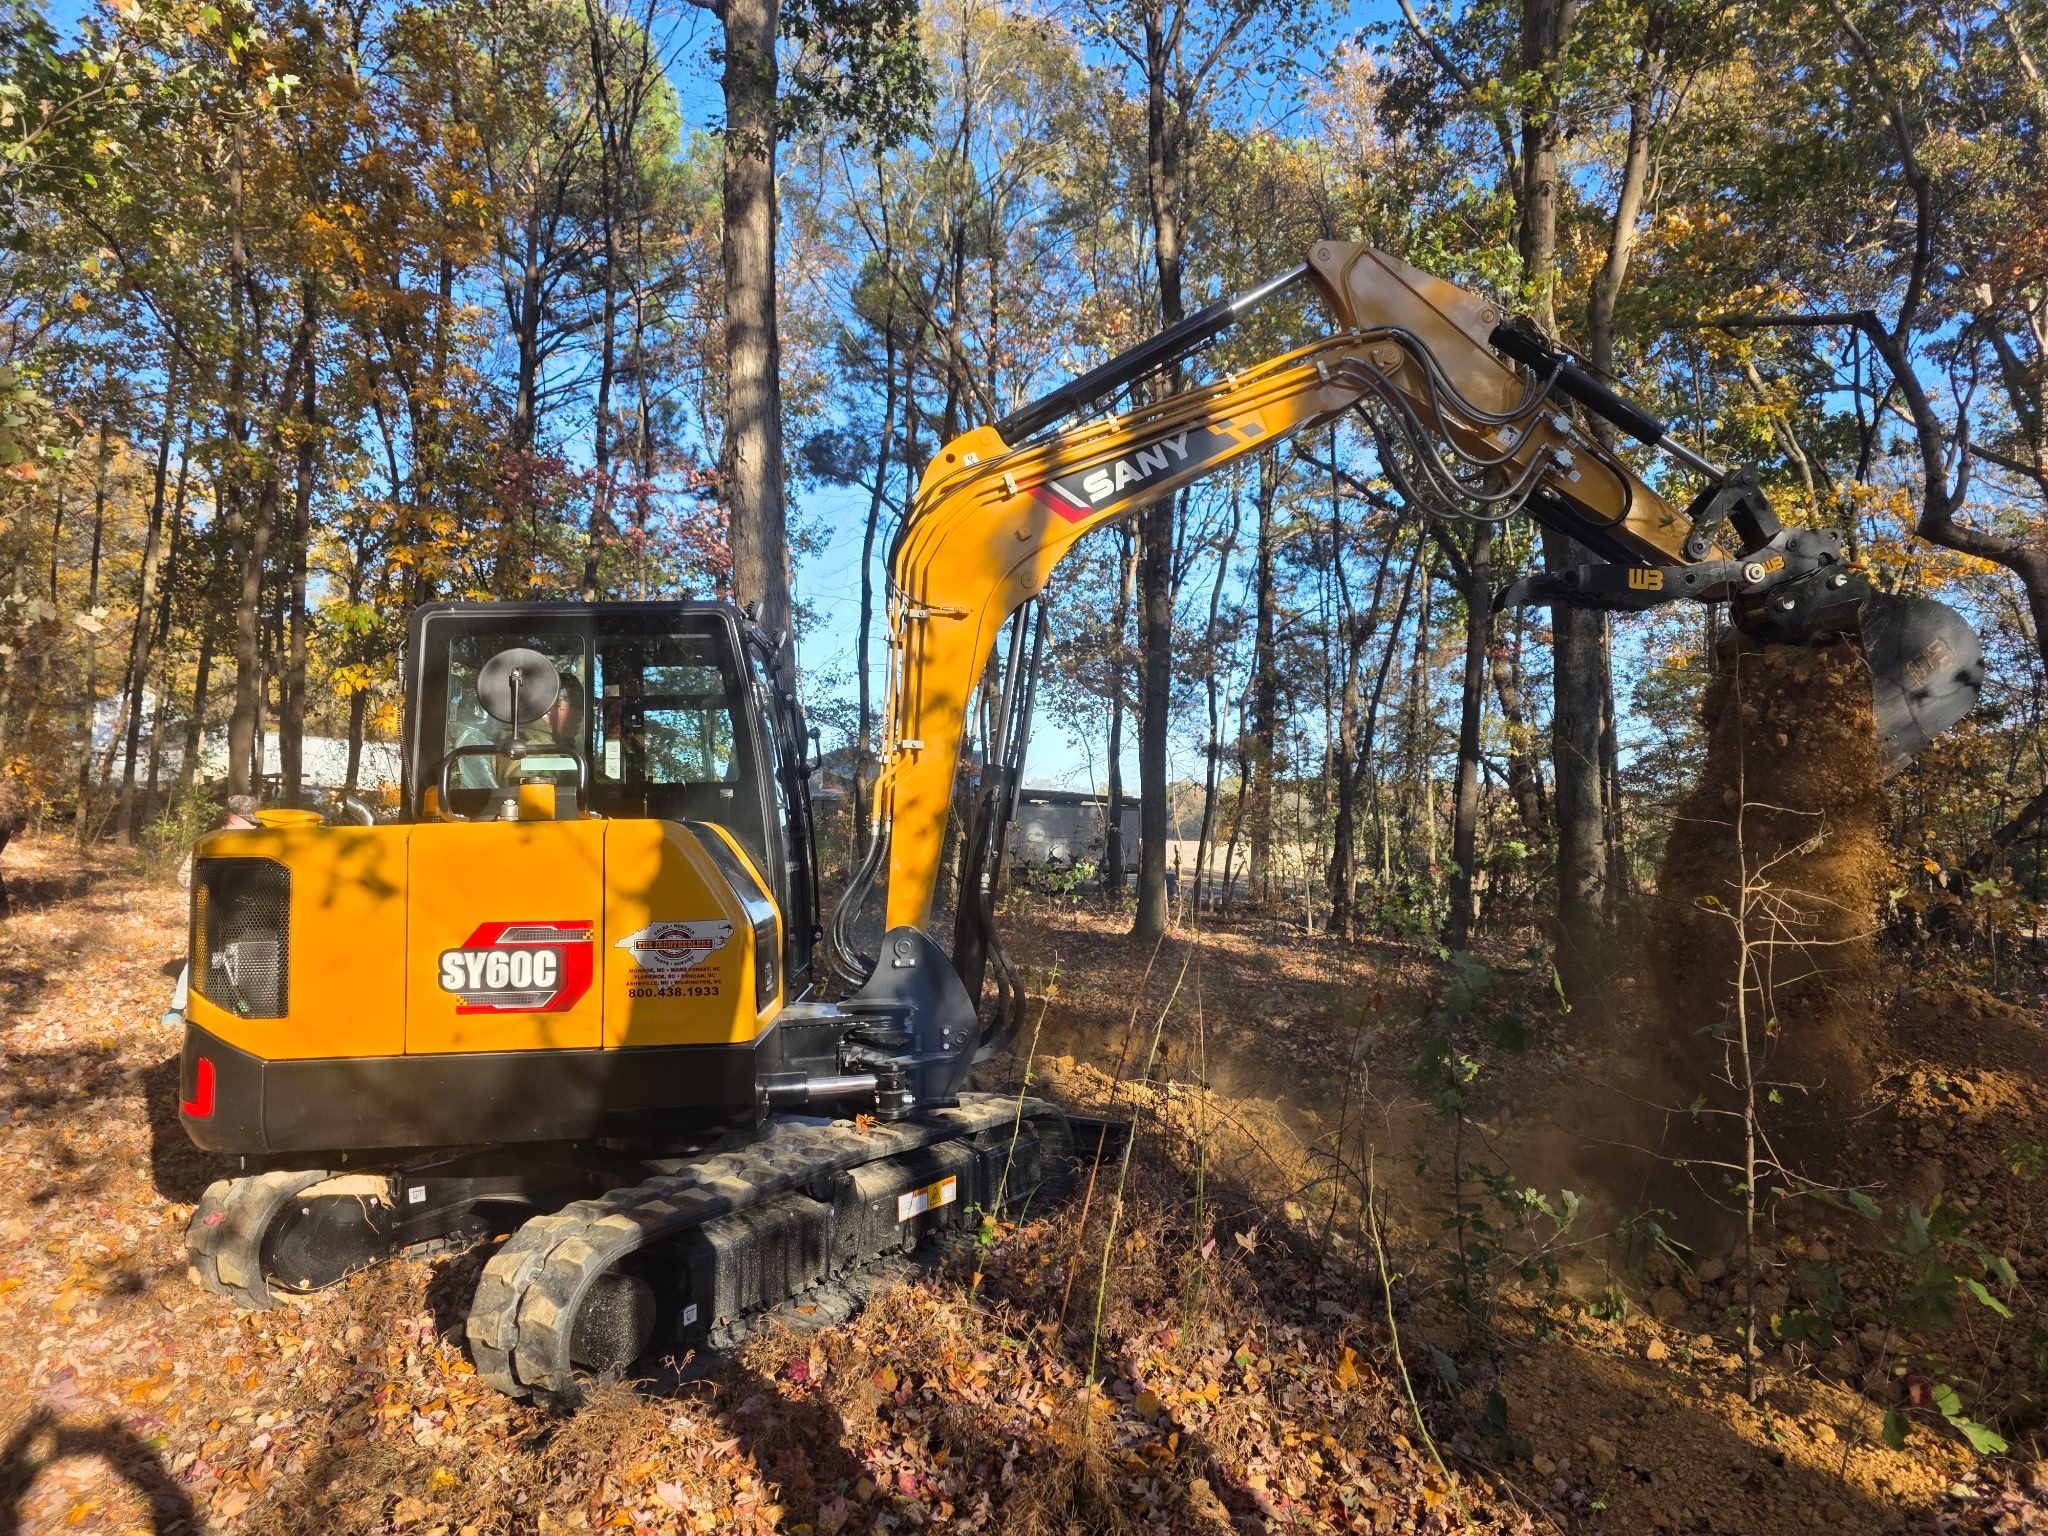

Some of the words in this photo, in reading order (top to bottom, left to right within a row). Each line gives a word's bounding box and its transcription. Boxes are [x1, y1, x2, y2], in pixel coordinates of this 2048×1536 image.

[1083, 432, 1190, 503] SANY
[654, 925, 668, 935] SALES
[674, 924, 695, 934] RENTALS
[654, 956, 668, 965] PARTS
[675, 956, 694, 965] SERVICE
[442, 950, 556, 989] SY60C
[629, 987, 719, 998] 800.438.1933
